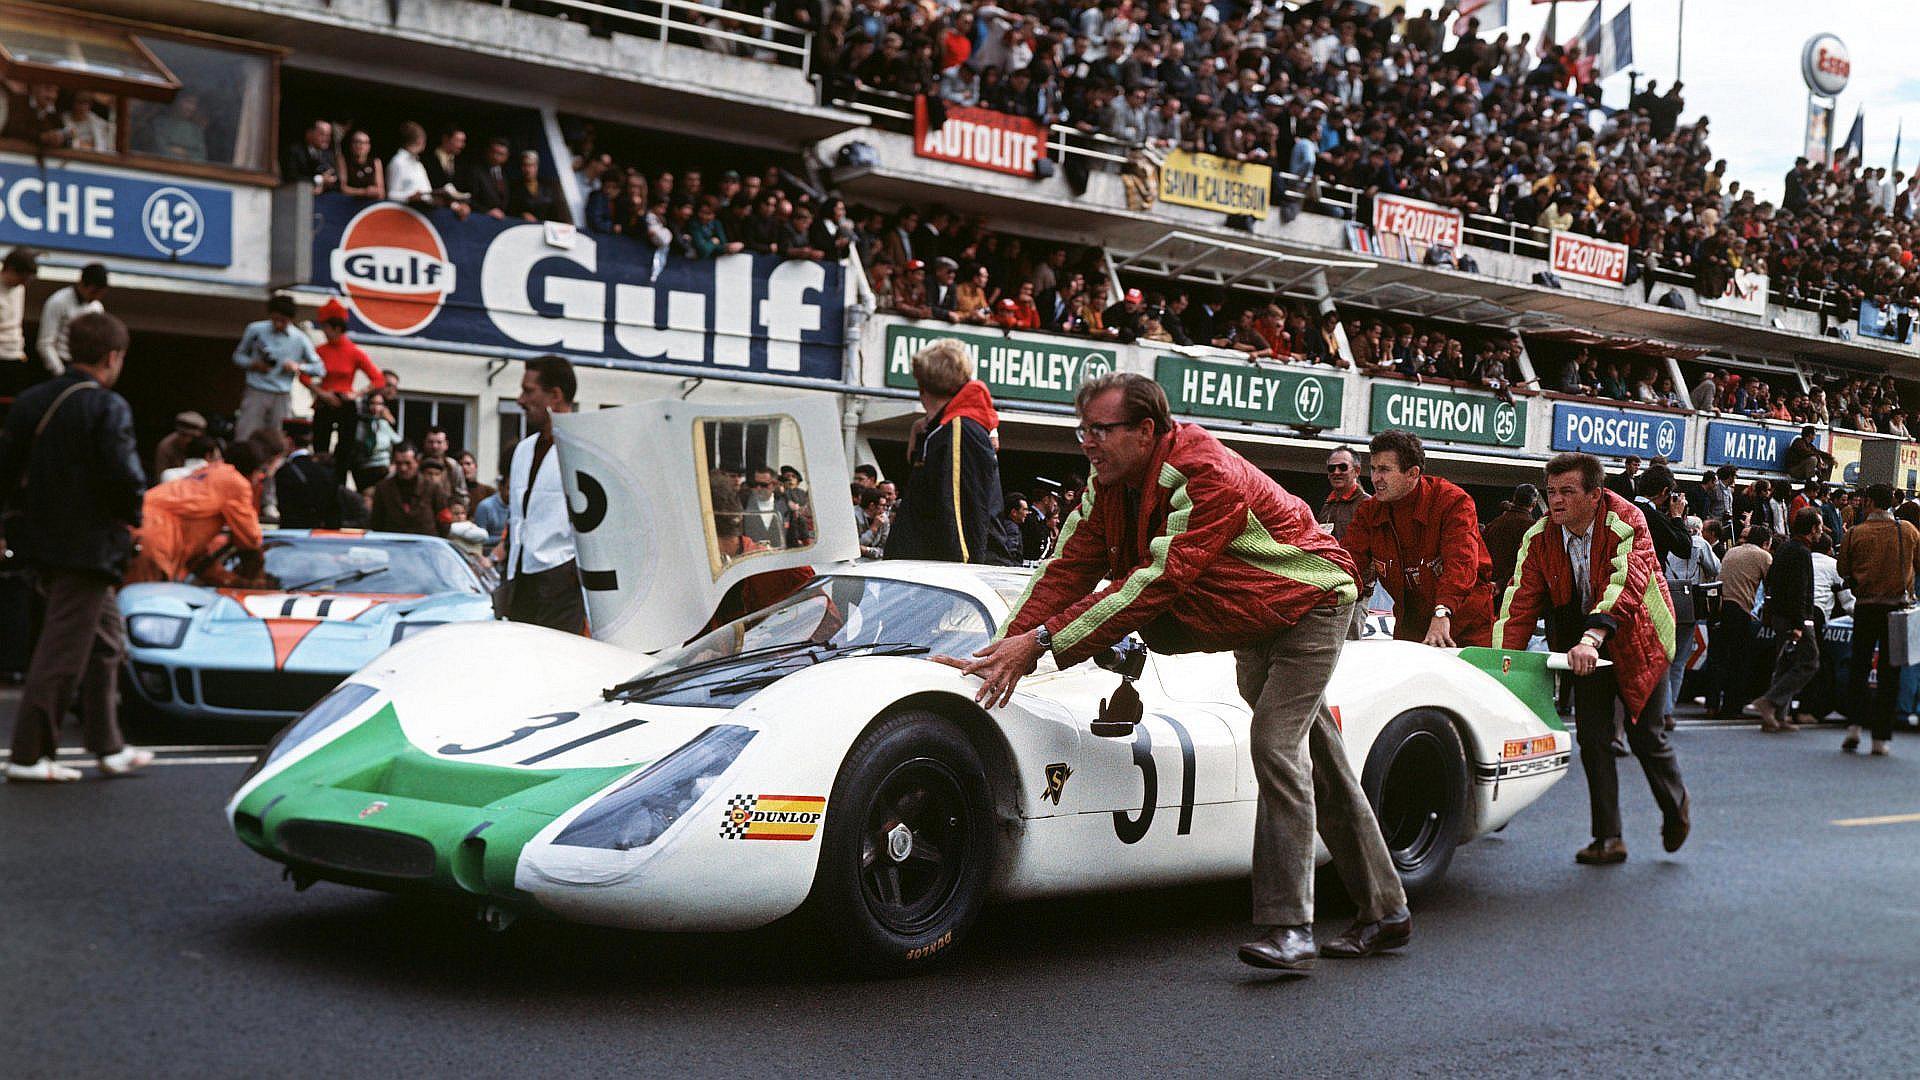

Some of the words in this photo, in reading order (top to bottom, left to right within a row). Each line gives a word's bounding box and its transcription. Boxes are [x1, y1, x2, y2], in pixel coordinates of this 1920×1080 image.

[1818, 48, 1850, 78] Esso
[924, 119, 1038, 173] AUTOLITE
[0, 176, 114, 239] CHE
[150, 198, 197, 243] 42
[1165, 169, 1266, 211] SAVIN-CALBERSON
[343, 253, 443, 287] Gulf
[480, 223, 826, 373] Gulf
[890, 335, 1079, 392] AUN-HEALEY
[1182, 369, 1281, 412] HEALEY
[1299, 385, 1320, 412] 47
[1386, 394, 1486, 434] CHEVRON
[1496, 411, 1514, 435] 25
[1567, 413, 1650, 450] PORSCHE
[1659, 426, 1674, 450] 64
[1724, 431, 1777, 462] MATRA
[280, 598, 334, 618] 11
[438, 710, 649, 766] 31
[1112, 712, 1197, 845] 31
[1509, 757, 1562, 774] PORSCHE
[752, 811, 821, 824] DUNLOP
[905, 931, 953, 961] DUNLOP
